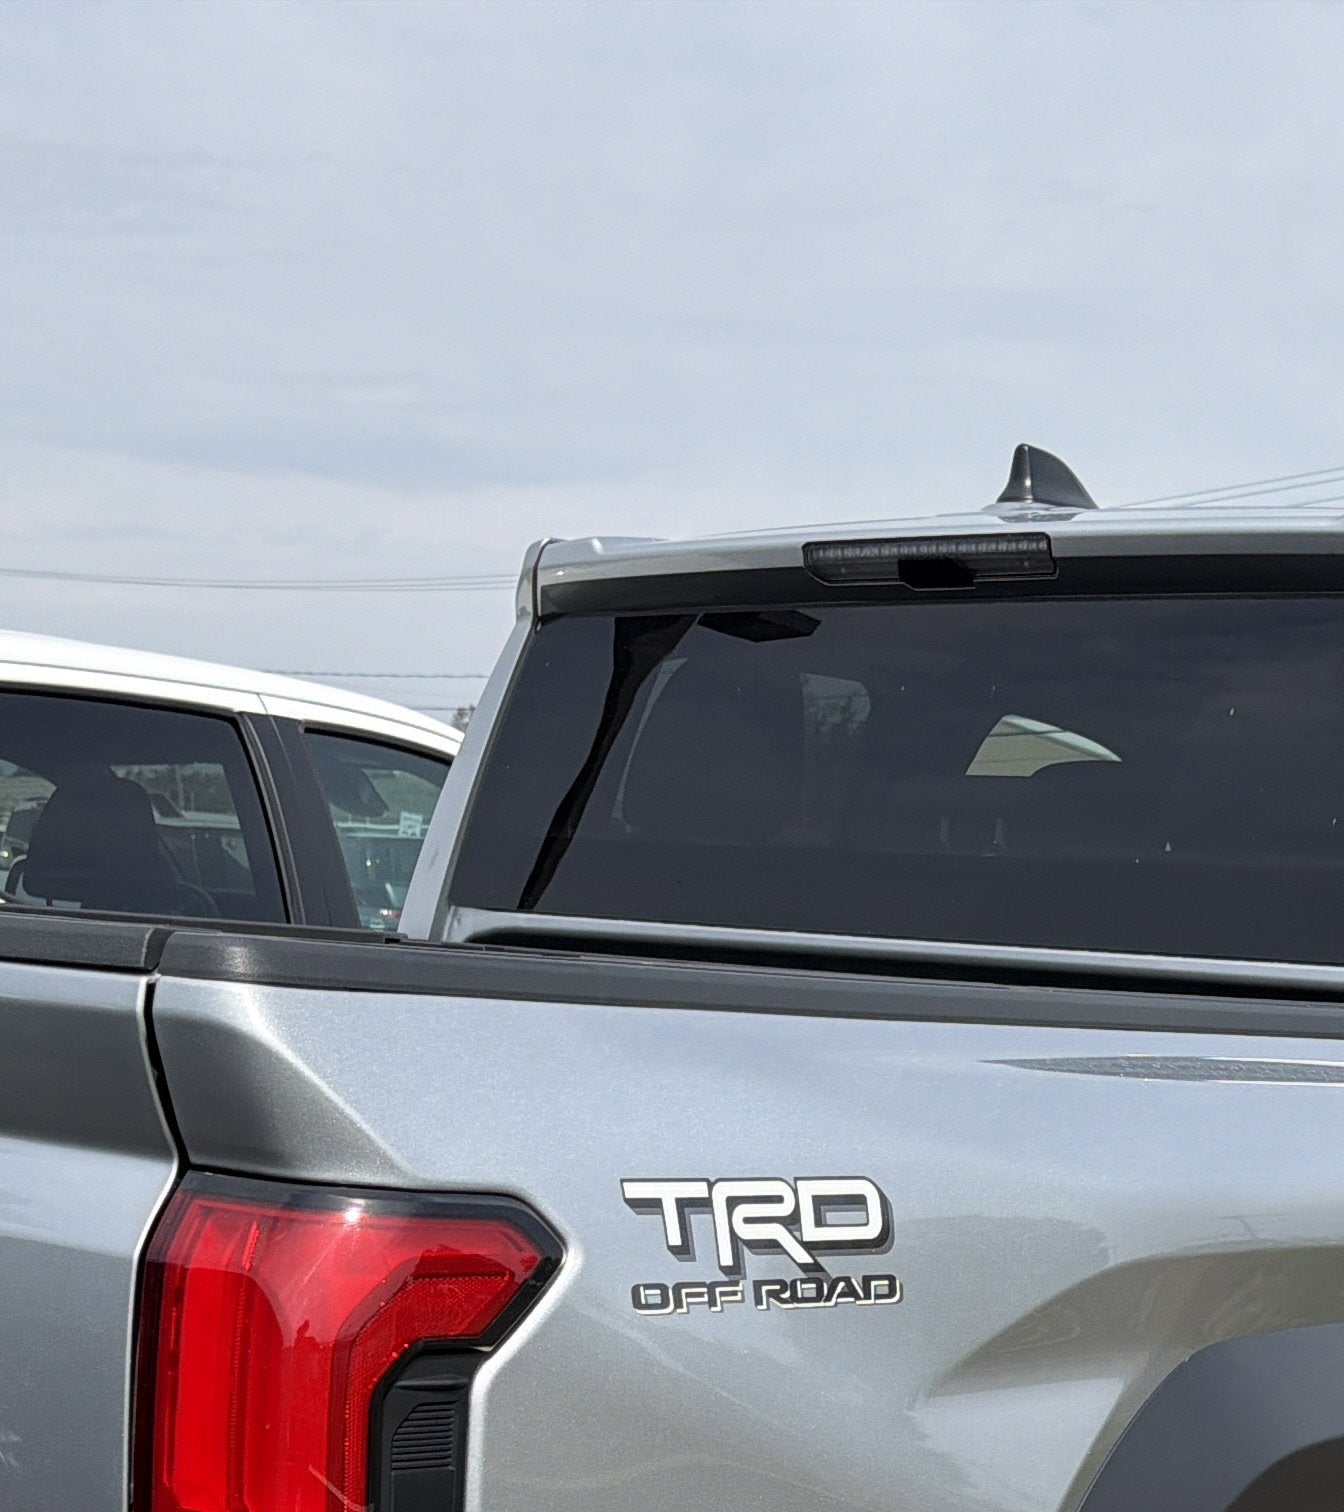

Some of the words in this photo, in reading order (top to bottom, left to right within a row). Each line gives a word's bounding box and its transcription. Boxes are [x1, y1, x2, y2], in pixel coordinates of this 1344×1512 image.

[620, 1176, 896, 1281] TRD
[631, 1281, 745, 1316] OFF
[753, 1275, 904, 1311] ROAD
